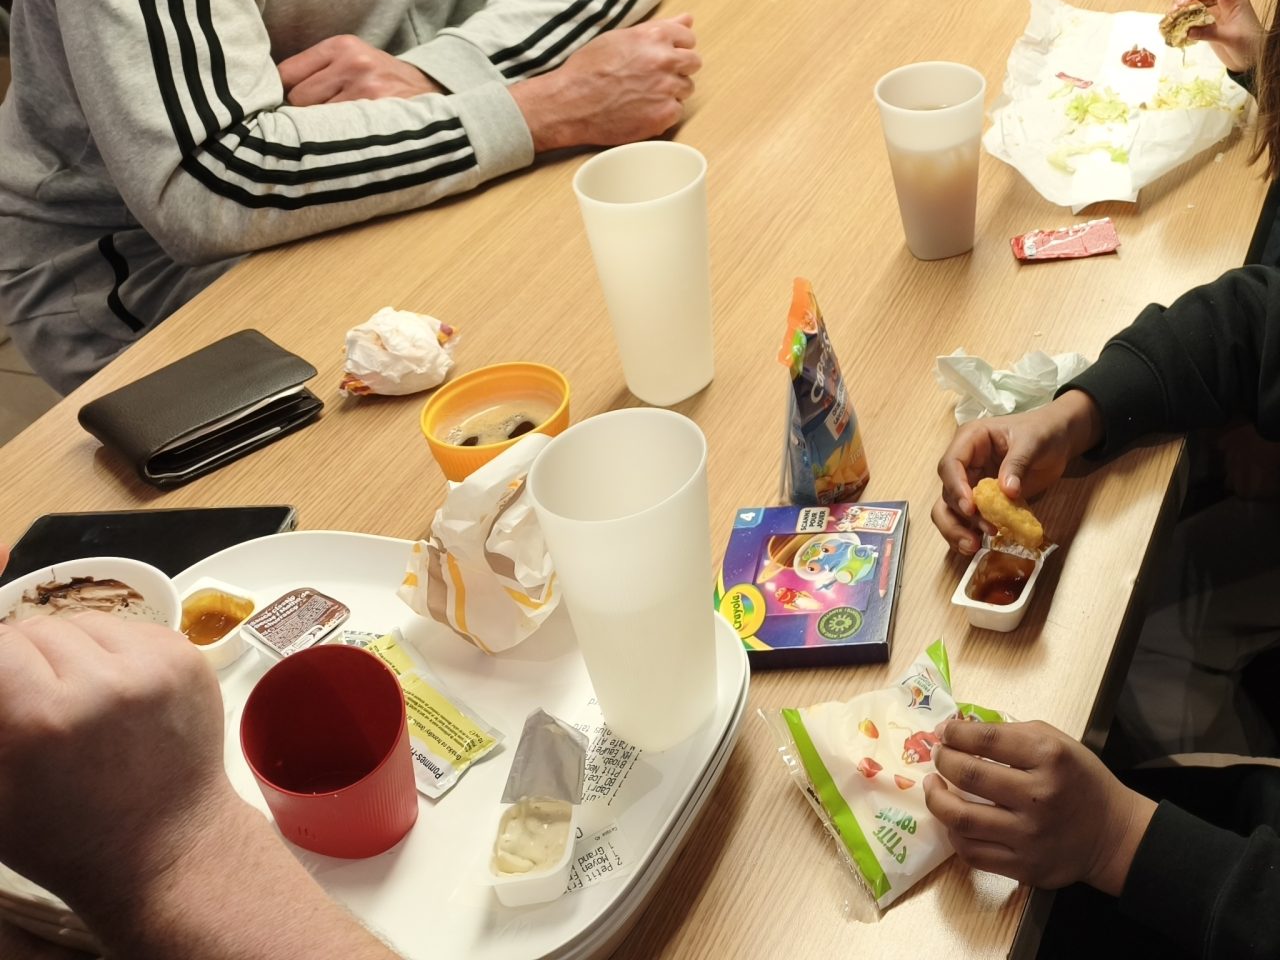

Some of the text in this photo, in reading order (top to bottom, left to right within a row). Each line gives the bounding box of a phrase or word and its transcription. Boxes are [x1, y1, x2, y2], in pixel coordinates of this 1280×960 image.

[740, 511, 756, 522] 4
[800, 509, 811, 531] SCANNE
[809, 512, 818, 527] POUR
[817, 510, 826, 528] JOUER
[732, 591, 742, 630] Crayola
[601, 766, 622, 777] Ptit
[585, 783, 610, 796] Capri
[872, 825, 908, 864] P'TITE
[577, 846, 605, 867] Grand
[581, 853, 610, 874] Moyen
[586, 864, 614, 882] Petit
